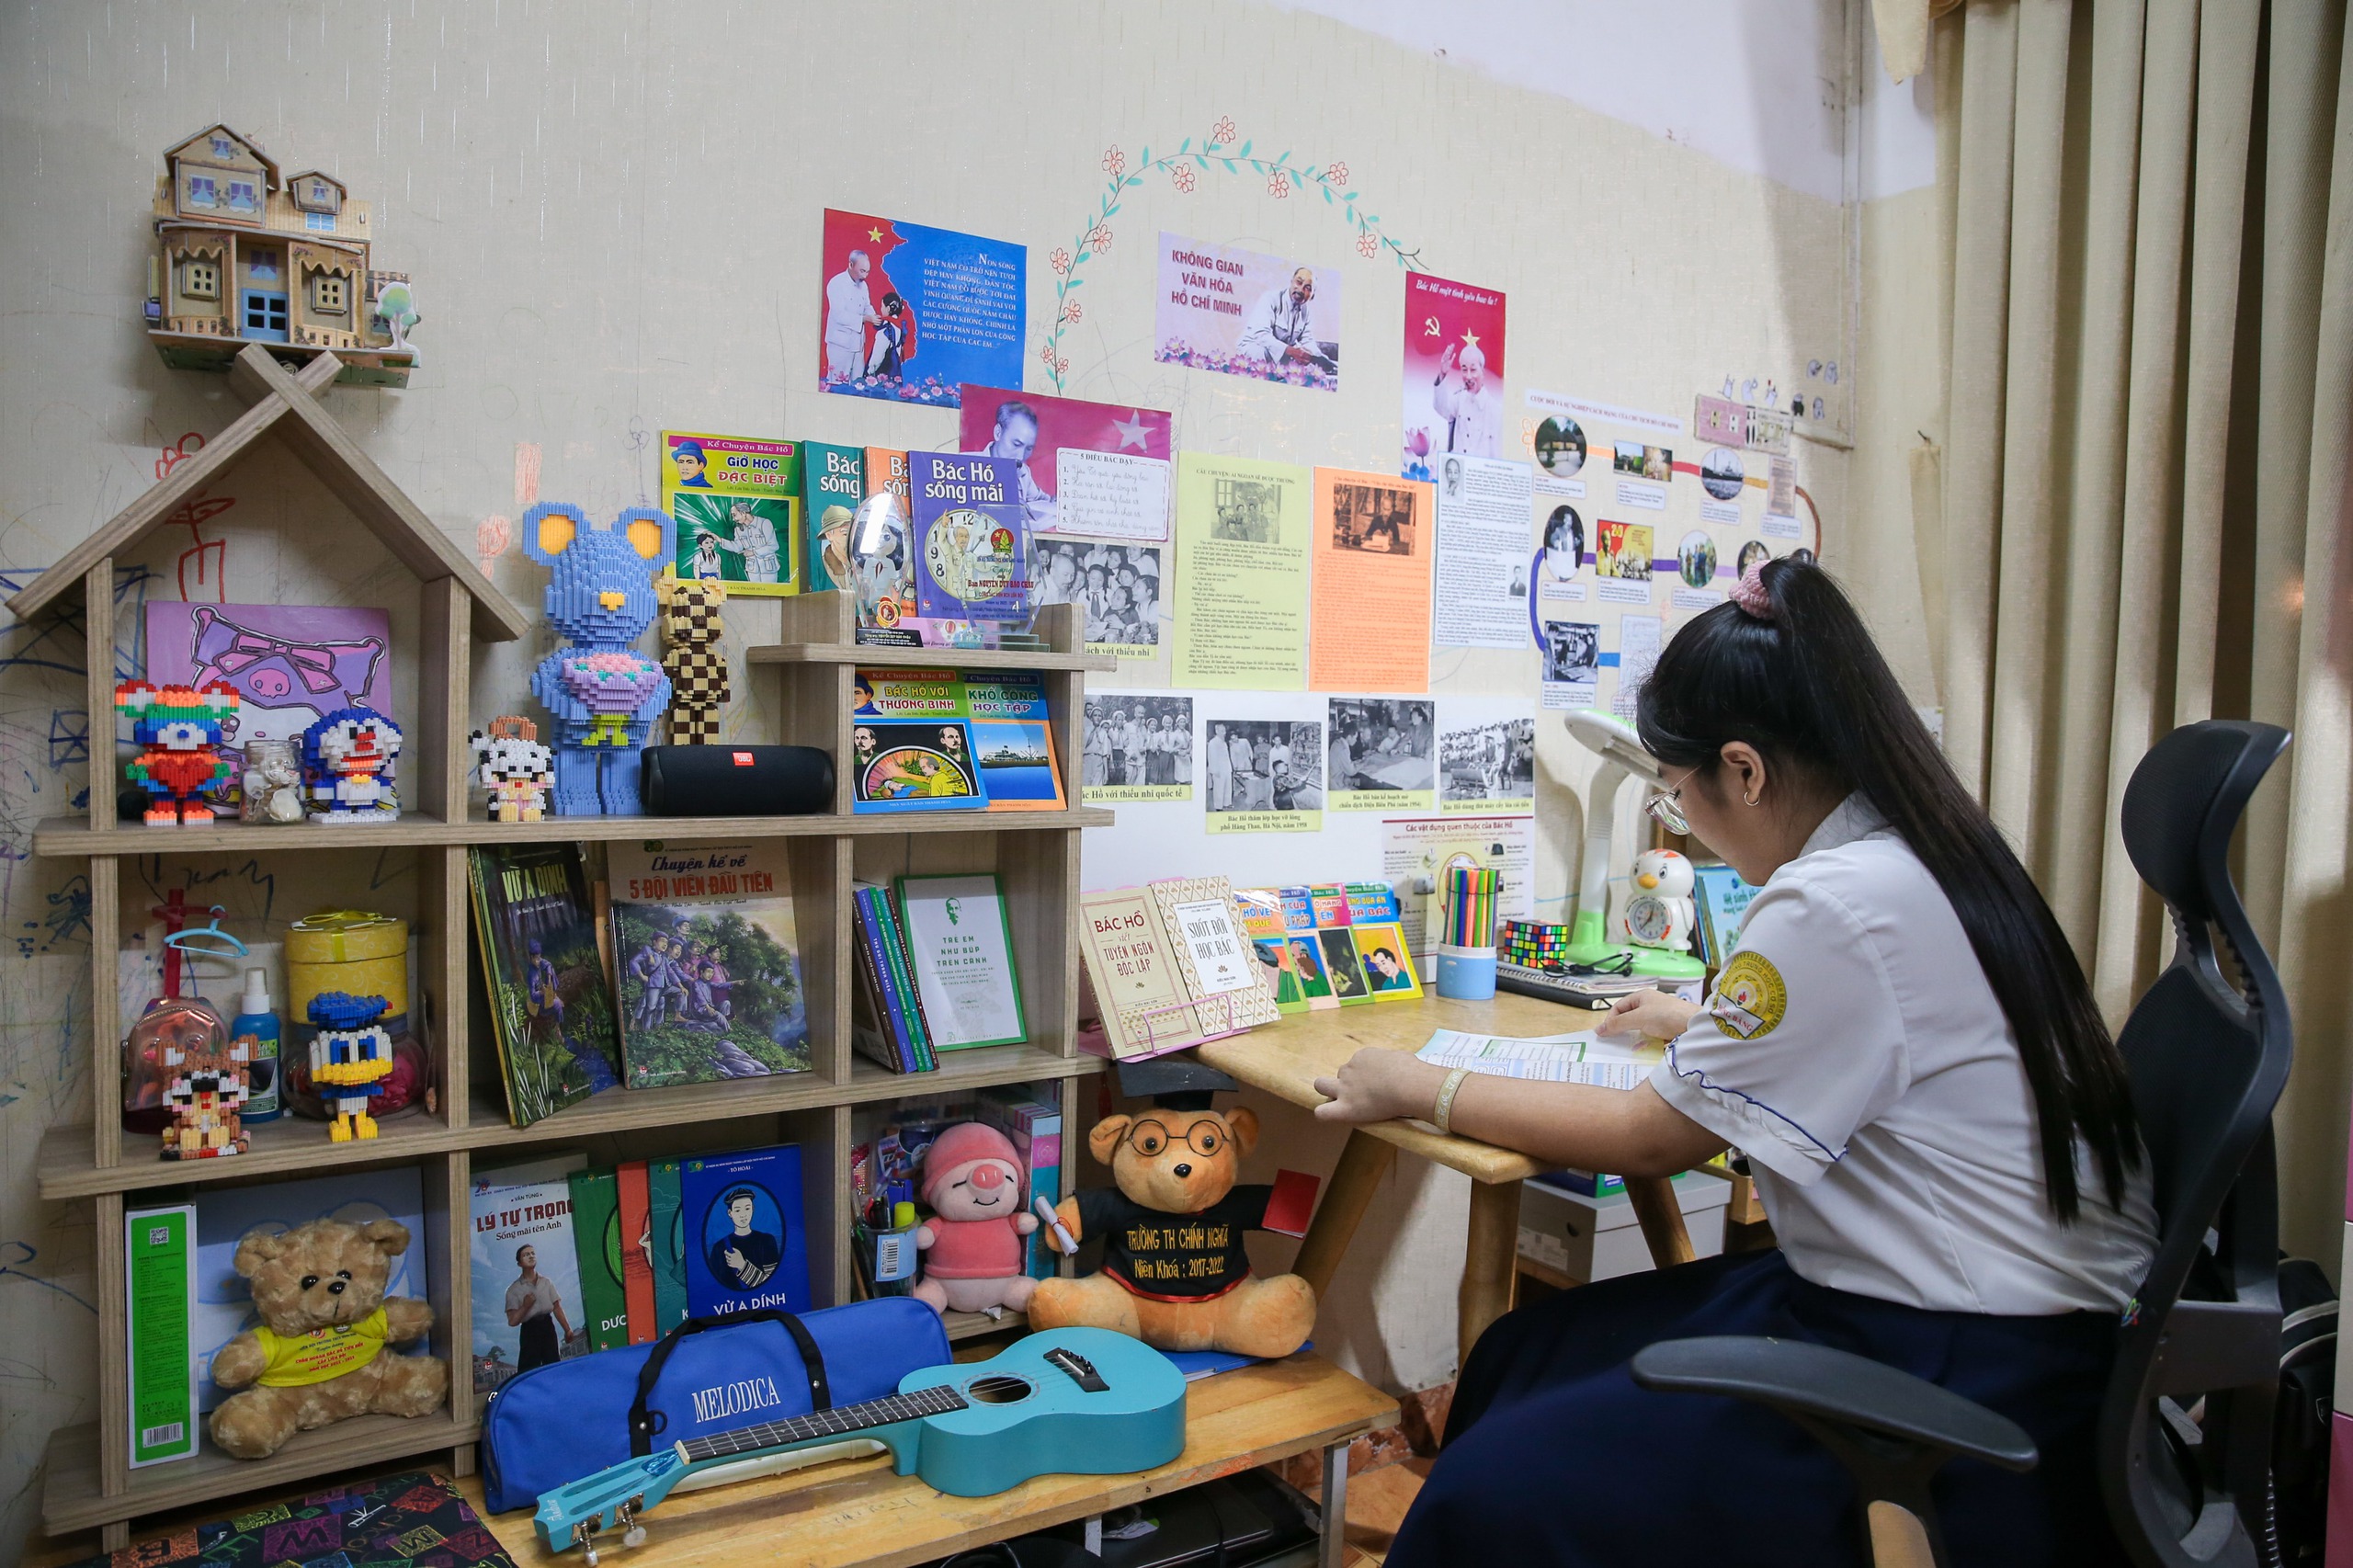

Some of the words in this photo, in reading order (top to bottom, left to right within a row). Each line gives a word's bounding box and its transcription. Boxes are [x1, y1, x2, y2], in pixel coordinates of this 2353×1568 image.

[1172, 249, 1213, 269] KHÔNG
[1216, 258, 1244, 277] GIAN
[1182, 271, 1206, 289] VĂN
[1210, 278, 1233, 294] HÓA
[1171, 288, 1188, 304] HỒ
[1191, 294, 1211, 309] CHÍ
[1213, 300, 1243, 316] MINH
[707, 439, 720, 448] Kể
[722, 441, 755, 451] Chuyện
[757, 444, 774, 452] Bác
[753, 458, 779, 474] HỌC
[826, 452, 860, 474] Bác
[932, 460, 965, 482] Bác
[971, 461, 995, 483] Hồ
[754, 472, 787, 487] BIỆT
[821, 475, 860, 499] sống
[926, 482, 967, 503] sống
[972, 483, 1004, 502] mãi
[1117, 645, 1135, 655] thiếu
[1138, 648, 1150, 656] nhi
[884, 686, 908, 698] BÁC
[912, 683, 926, 698] HỒ
[930, 686, 949, 697] VỚI
[879, 699, 924, 710] THƯƠNG
[927, 699, 955, 710] BINH
[972, 703, 999, 713] HỌC
[1092, 788, 1103, 799] Hồ
[1106, 790, 1118, 798] với
[1120, 787, 1139, 798] thiếu
[1156, 787, 1173, 800] quốc
[652, 856, 704, 873] Chuyện
[708, 854, 728, 869] kể
[730, 854, 747, 868] về
[630, 879, 639, 899] 5
[643, 875, 668, 900] ĐỘI
[672, 874, 705, 897] VIÊN
[708, 871, 737, 895] ĐẦU
[741, 870, 773, 892] TIÊN
[1094, 915, 1121, 933] BÁC
[1123, 910, 1145, 928] HỒ
[1368, 905, 1391, 916] BÁC
[1188, 917, 1211, 938] SUỐT
[1211, 916, 1228, 935] ĐỜI
[1103, 943, 1129, 961] TUYÊN
[1132, 940, 1154, 956] NGÔN
[1196, 941, 1216, 960] HỌC
[1215, 937, 1234, 956] BÁC
[1117, 960, 1134, 977] ĐỘC
[1135, 958, 1151, 973] LẬP
[476, 1210, 495, 1233] LÝ
[500, 1208, 522, 1227] TỰ
[496, 1231, 517, 1241] Sống
[517, 1228, 531, 1236] mãi
[532, 1224, 545, 1233] tên
[546, 1221, 562, 1231] Anh
[1126, 1223, 1160, 1251] TRƯỜNG
[1164, 1230, 1176, 1250] TH
[1177, 1221, 1205, 1250] CHÍNH
[1207, 1223, 1229, 1248] NGHĨA
[1133, 1259, 1154, 1279] Niên
[1155, 1258, 1179, 1278] Khóa
[1188, 1256, 1224, 1278] 2017-2022
[713, 1300, 734, 1316] VỪ
[738, 1300, 747, 1311] A
[751, 1293, 786, 1310] DÍNH
[691, 1375, 781, 1424] MELODICA
